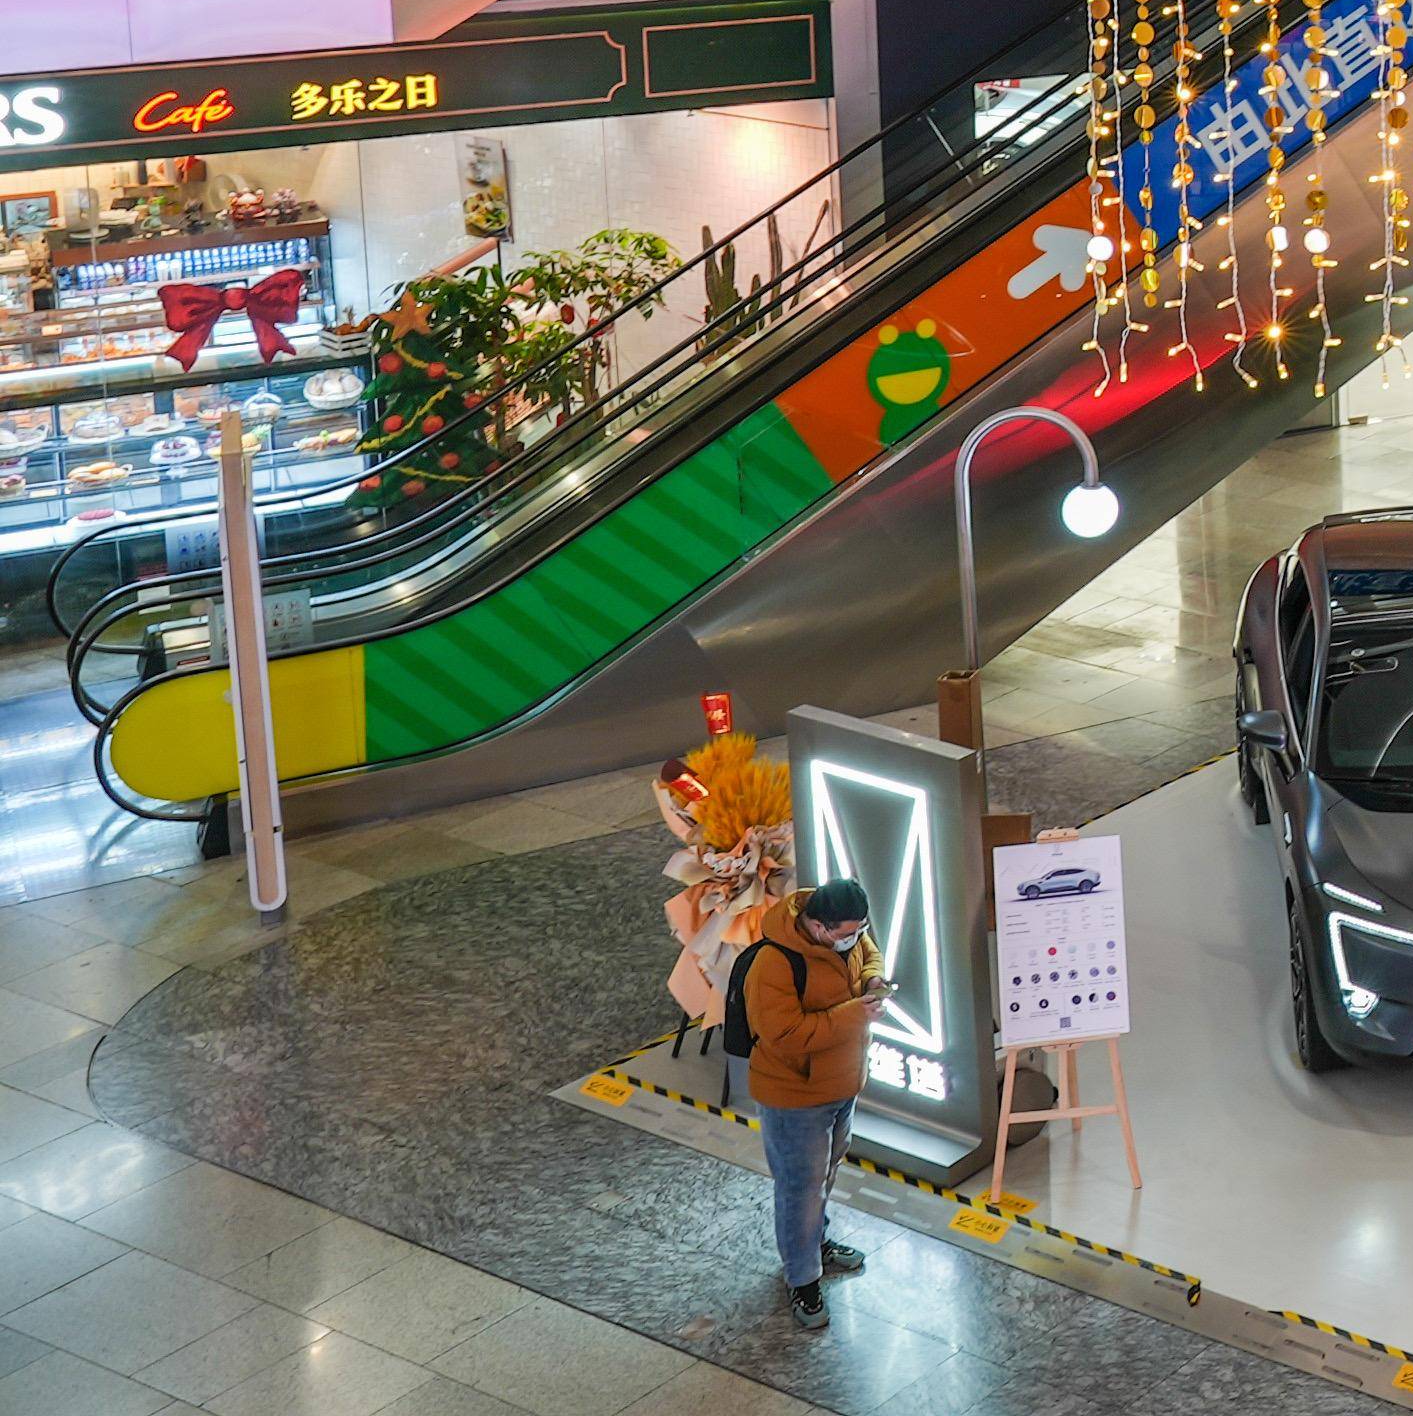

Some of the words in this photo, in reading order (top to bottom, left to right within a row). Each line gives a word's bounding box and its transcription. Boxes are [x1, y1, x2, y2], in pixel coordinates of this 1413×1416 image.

[133, 88, 235, 133] Café
[290, 73, 439, 121] 多乐之日
